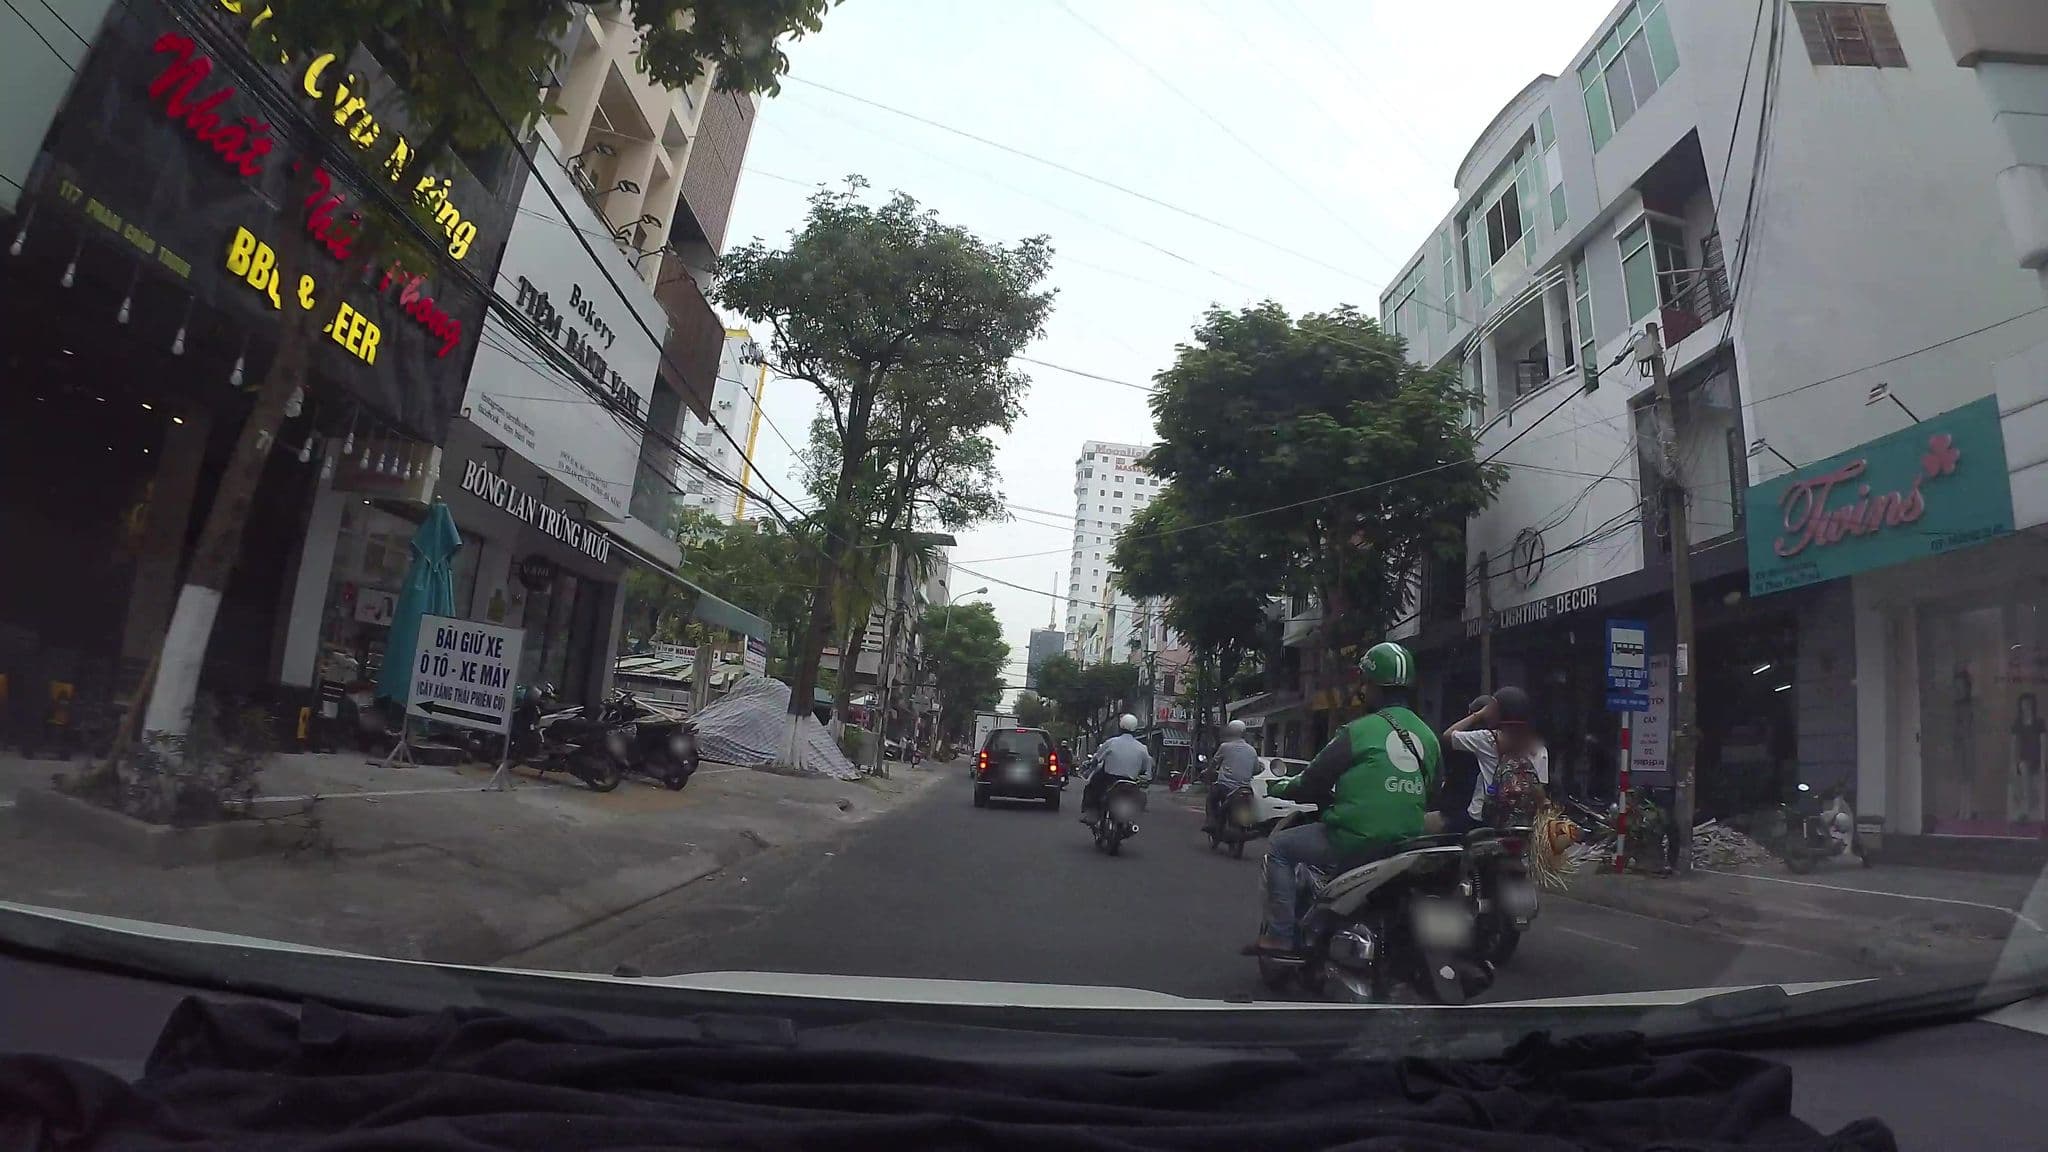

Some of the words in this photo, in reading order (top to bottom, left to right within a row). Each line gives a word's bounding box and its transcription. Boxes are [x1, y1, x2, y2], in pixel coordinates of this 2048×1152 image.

[297, 274, 317, 311] &
[323, 302, 382, 366] EER
[569, 283, 616, 350] Bakery
[461, 459, 507, 507] BÔNG
[505, 484, 537, 525] LAN
[538, 508, 581, 549] TRỨNG
[580, 531, 612, 564] MUỐI
[1774, 459, 1925, 558] Twins
[1499, 600, 1548, 629] LIGHTING
[1556, 586, 1597, 615] DECOR
[420, 649, 430, 674] Ô
[433, 652, 449, 678] TÔ
[460, 660, 478, 684] XE
[480, 662, 511, 689] MÁY
[435, 625, 458, 651] BÃI
[460, 630, 486, 655] GIỮ
[485, 635, 504, 659] XE
[1384, 775, 1425, 795] Grab
